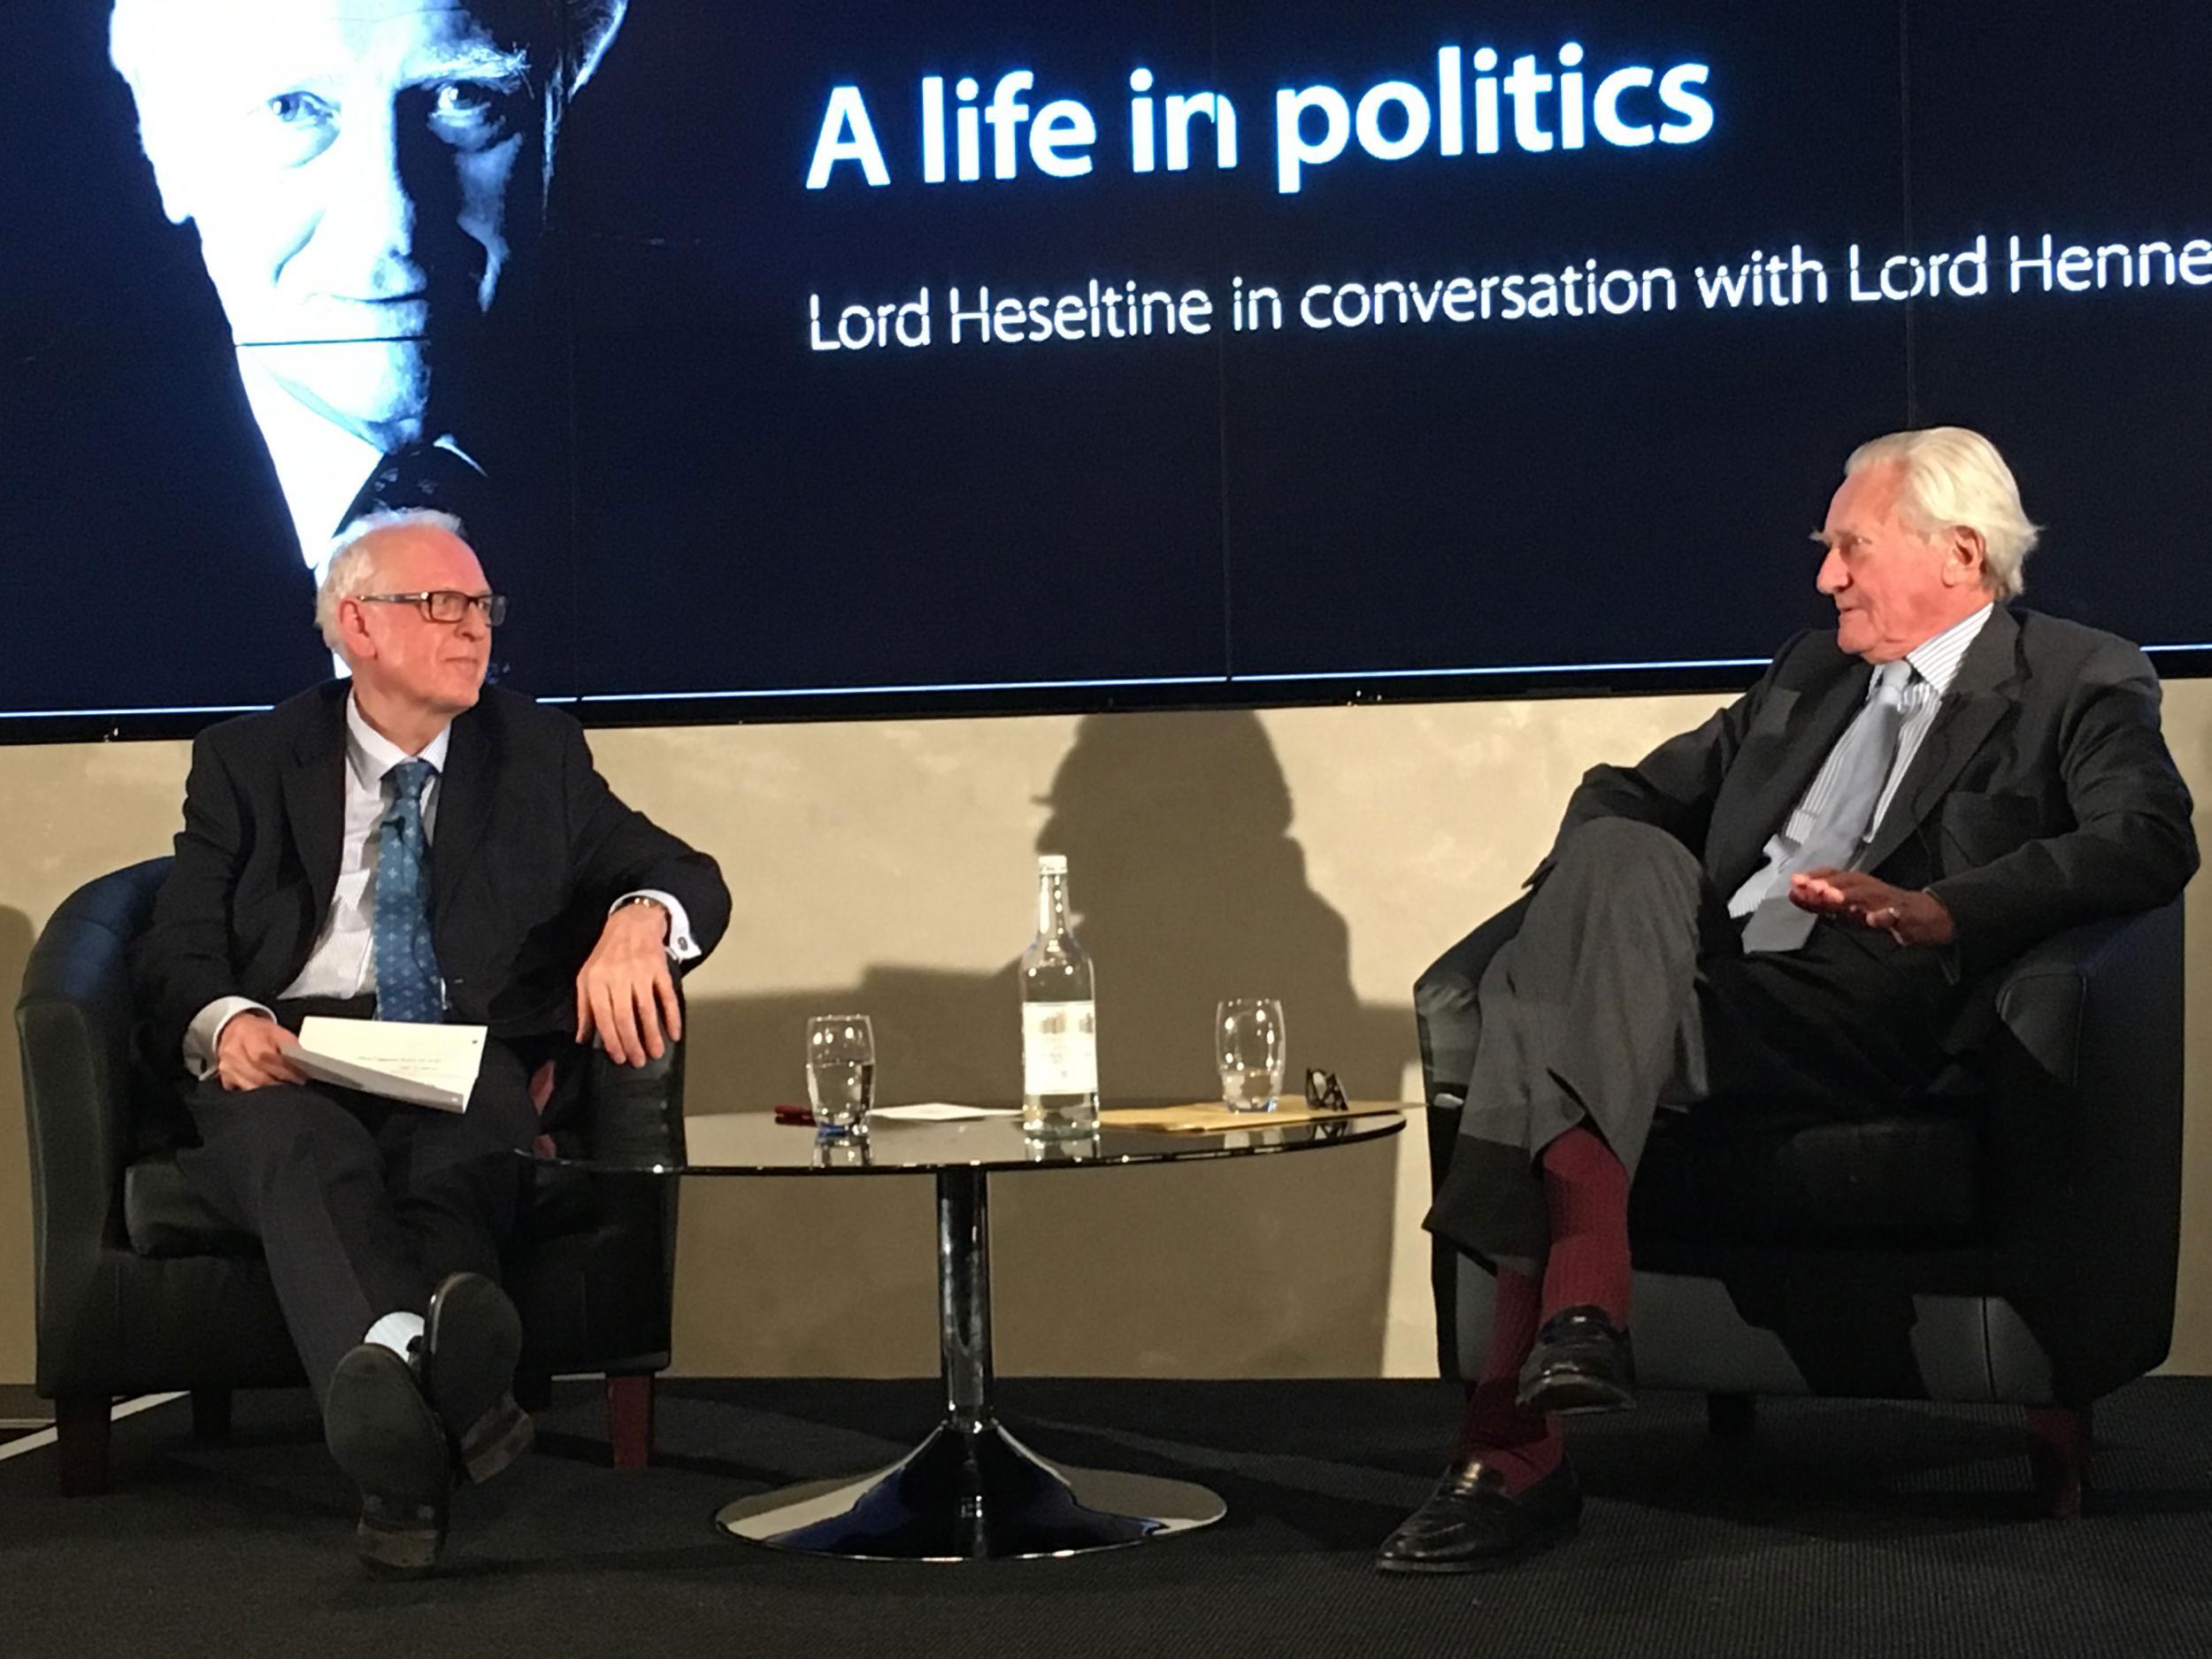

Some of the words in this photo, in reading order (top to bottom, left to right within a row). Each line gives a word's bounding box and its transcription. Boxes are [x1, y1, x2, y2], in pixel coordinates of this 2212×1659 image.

[805, 85, 891, 189] A
[921, 69, 1097, 183] life
[1129, 67, 1238, 173] in
[1276, 41, 1715, 194] politics
[809, 285, 932, 351] Lord
[949, 278, 1214, 345] Heseltine
[1231, 275, 1283, 332] in
[1299, 257, 1678, 329] conversation
[1694, 243, 1829, 310] with
[1848, 234, 1989, 303] Lord
[2008, 233, 2212, 295] Henne
